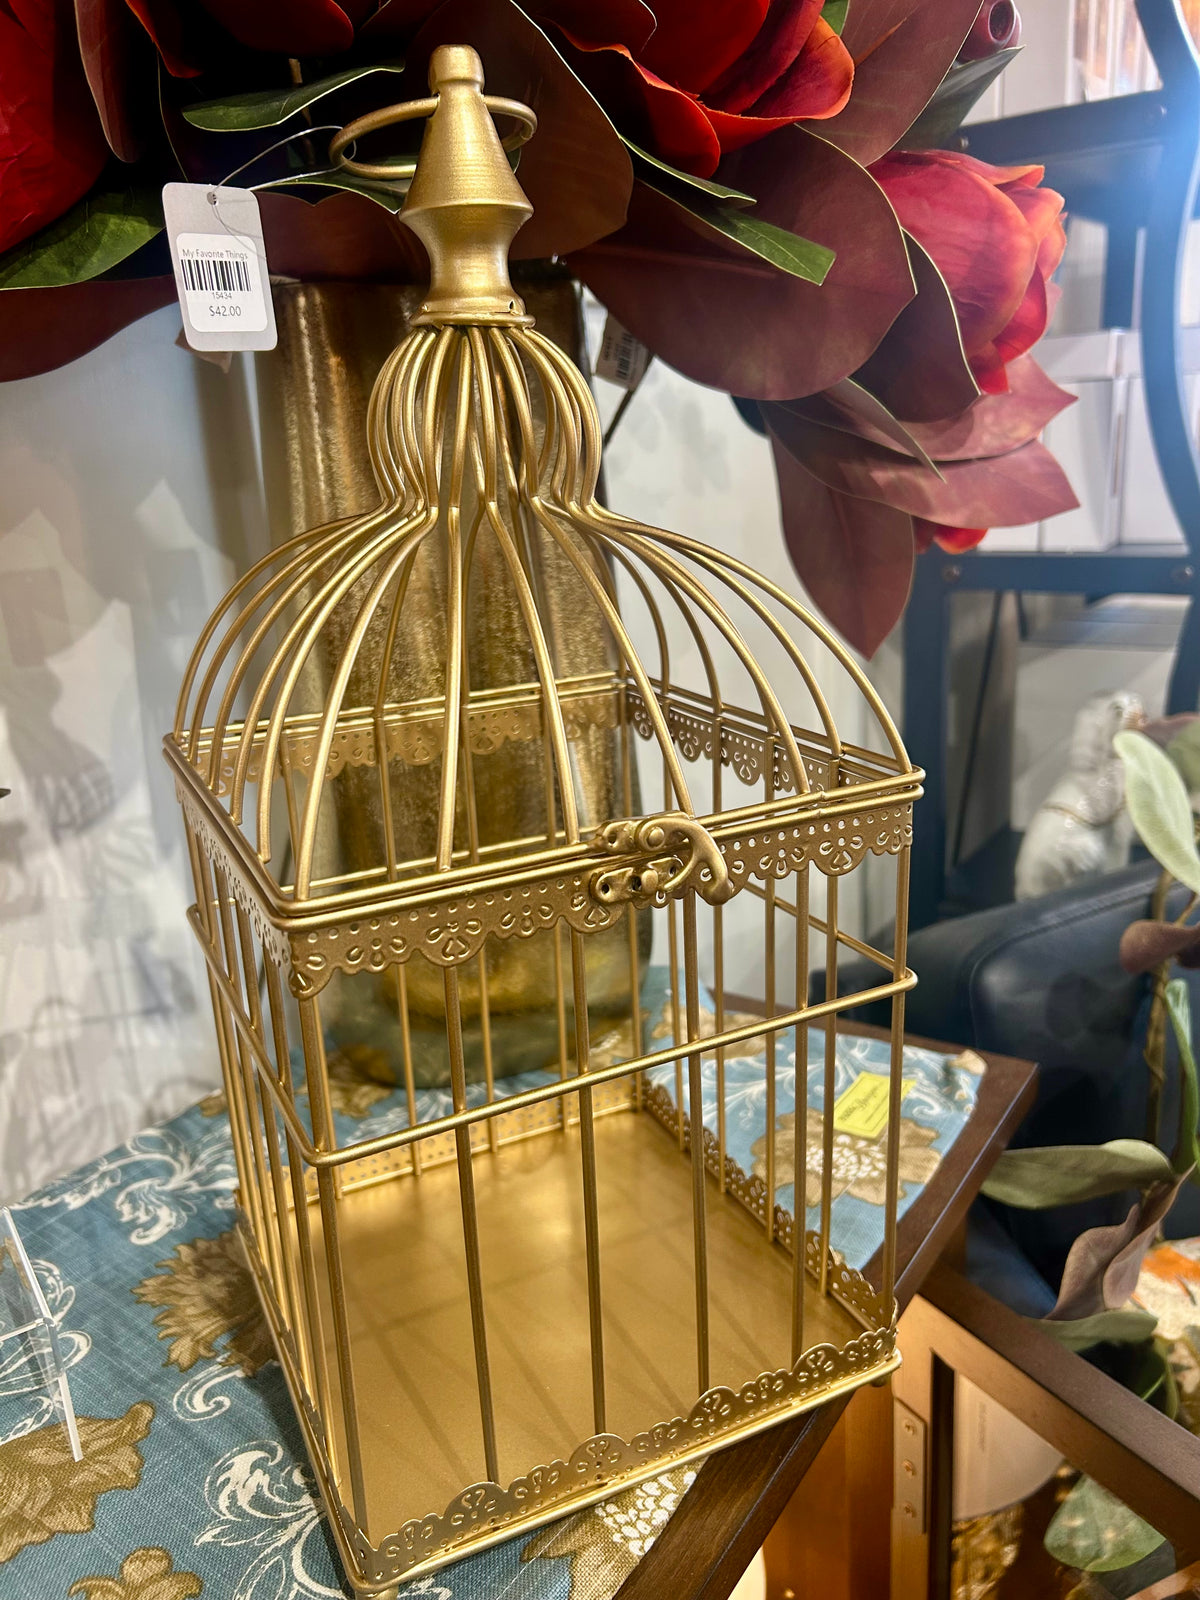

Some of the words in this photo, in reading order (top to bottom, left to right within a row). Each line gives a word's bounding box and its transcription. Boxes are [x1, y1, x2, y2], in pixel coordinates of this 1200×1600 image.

[182, 248, 194, 259] My
[195, 249, 224, 259] Favorite
[225, 250, 248, 261] Things
[212, 292, 232, 300] 15434
[209, 305, 241, 317] $42.00
